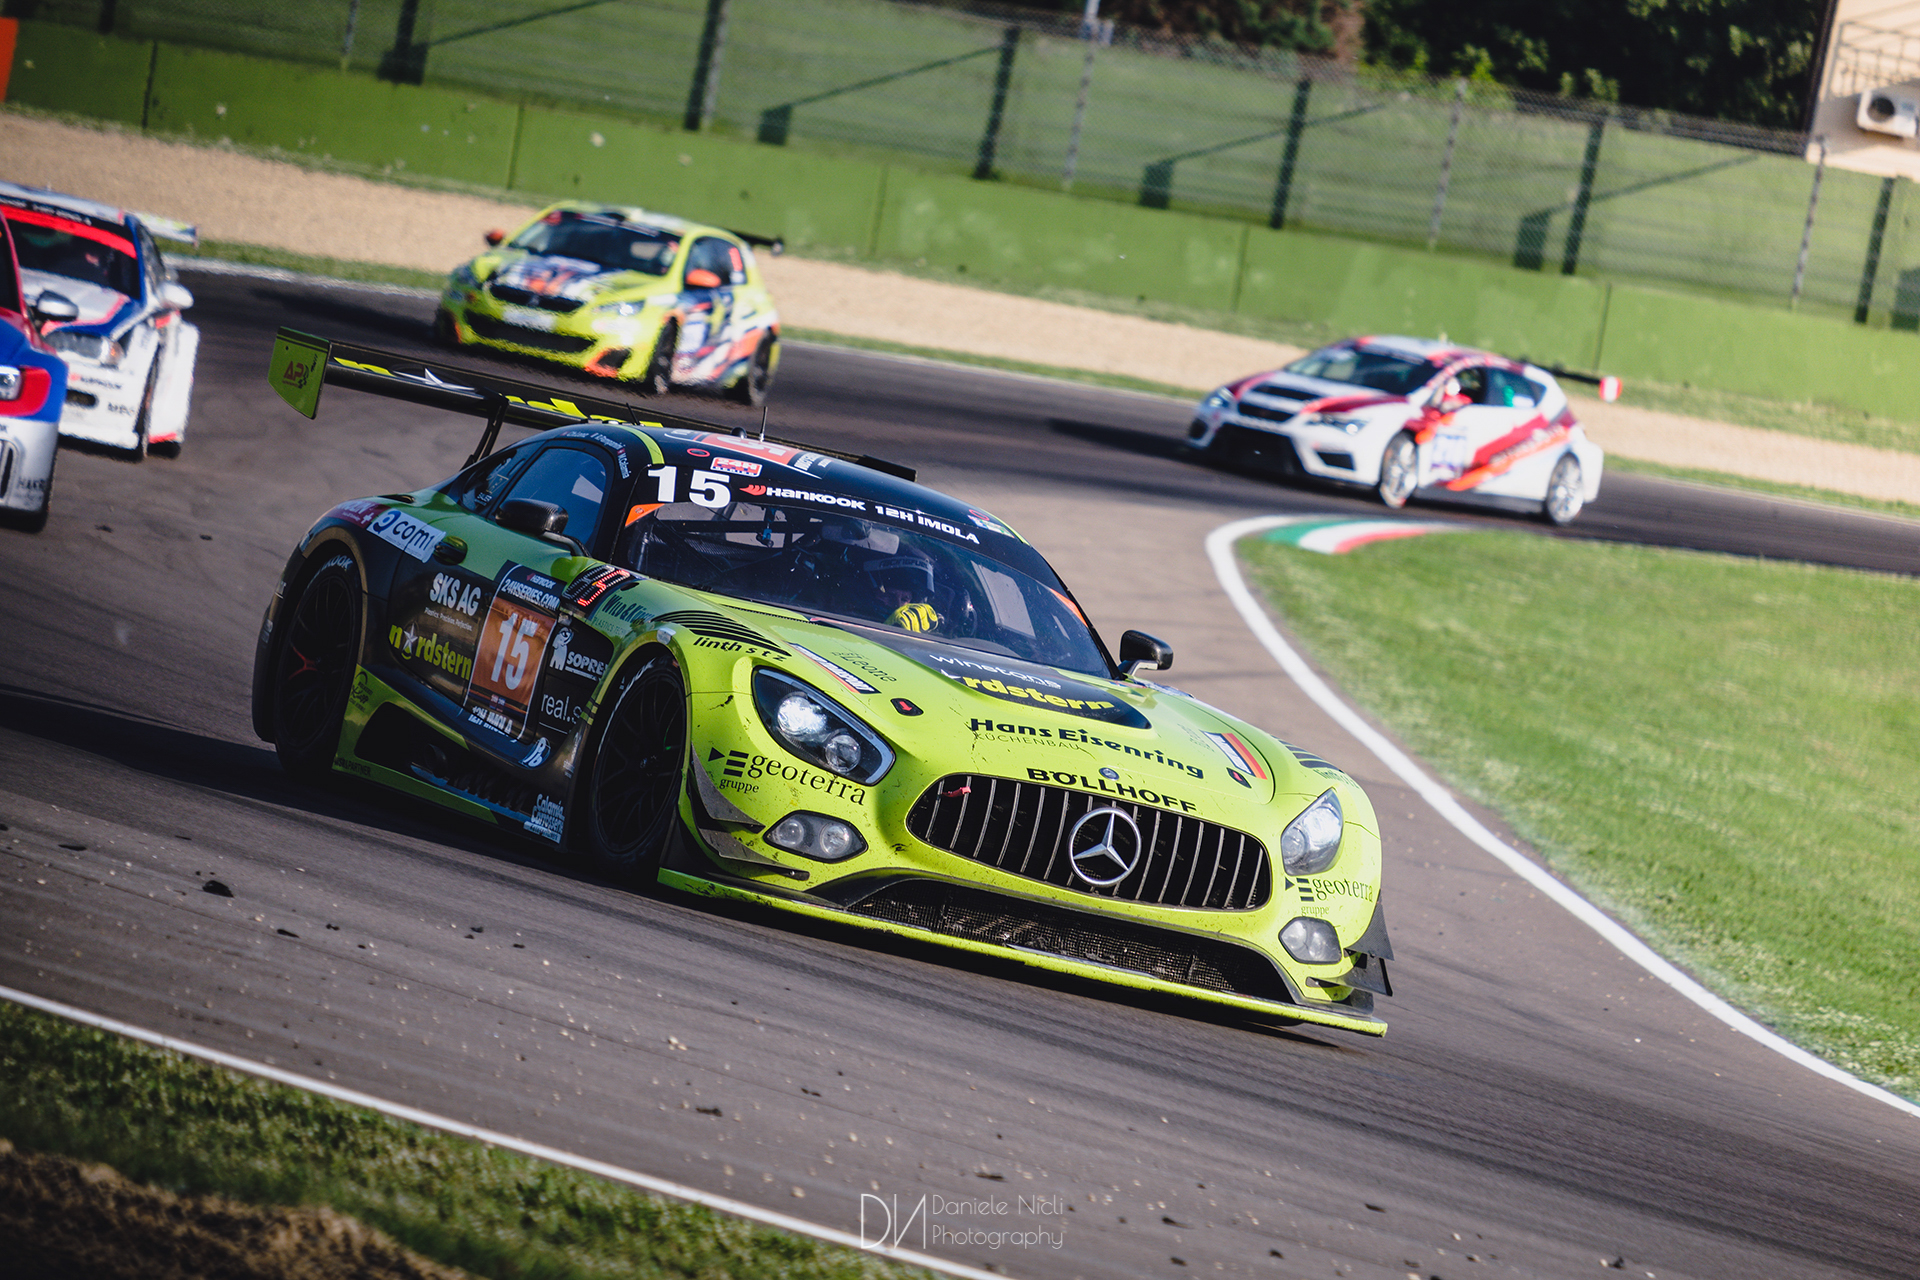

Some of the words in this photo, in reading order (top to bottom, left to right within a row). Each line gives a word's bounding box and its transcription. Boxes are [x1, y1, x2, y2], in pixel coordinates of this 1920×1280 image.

[647, 464, 732, 509] 15
[874, 505, 915, 523] 12H
[429, 572, 461, 609] SKS
[456, 583, 482, 617] AG
[490, 612, 539, 691] 15
[693, 636, 742, 652] linth
[970, 717, 1053, 738] Hans
[1058, 728, 1204, 780] Eisenring
[719, 777, 760, 794] gruppe
[747, 754, 867, 807] geoterra
[1026, 767, 1198, 813] BÖLLHOFF
[1300, 905, 1330, 917] gruppe
[1312, 878, 1374, 903] geoterra
